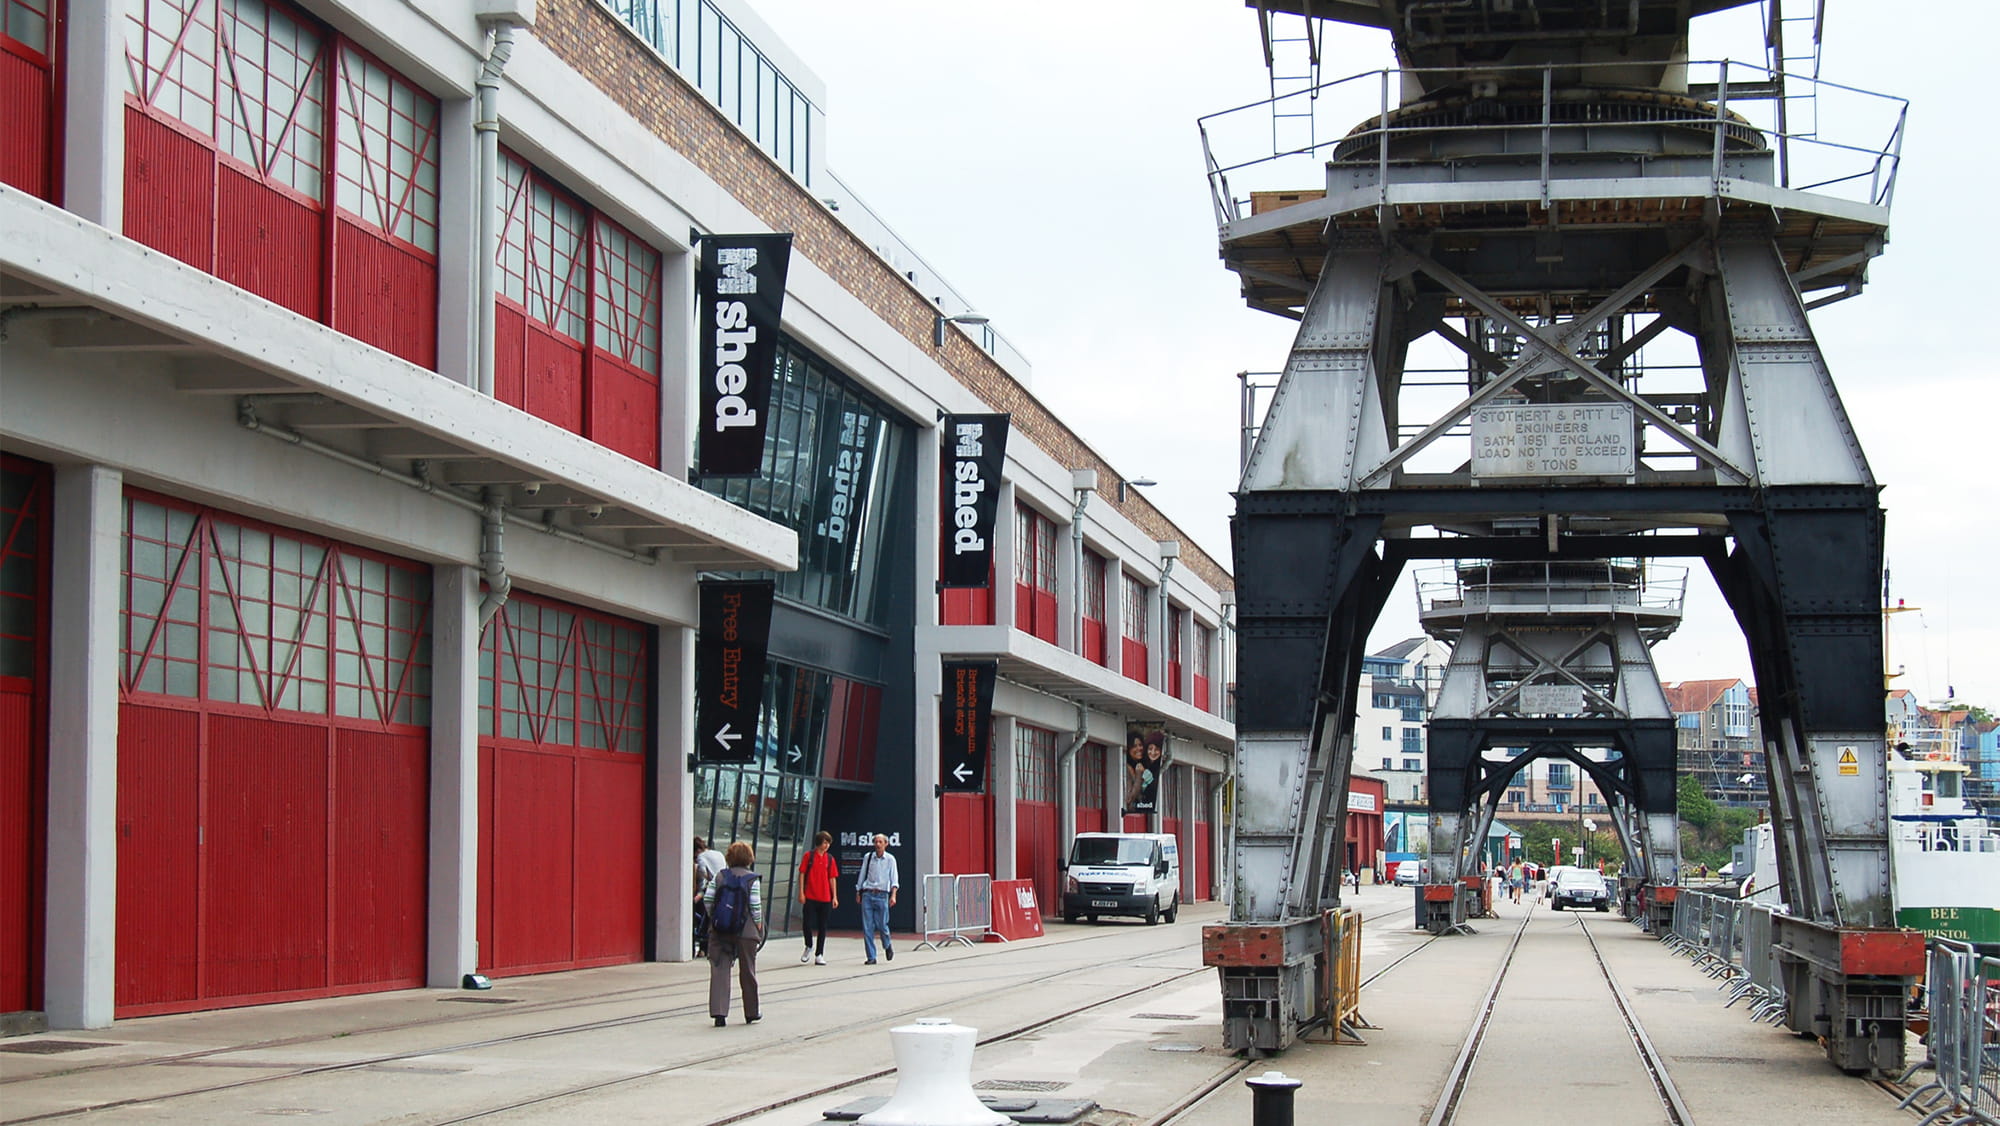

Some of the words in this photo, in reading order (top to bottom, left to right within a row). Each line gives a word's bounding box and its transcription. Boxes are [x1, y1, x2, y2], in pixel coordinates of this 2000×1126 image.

[717, 248, 757, 294] M
[716, 301, 756, 432] shed
[1480, 410, 1551, 422] STOTHERT
[1556, 411, 1566, 421] &
[1573, 409, 1604, 421] PITT
[1515, 423, 1588, 433] ENGINEERS
[956, 423, 983, 457] M
[1483, 436, 1515, 446] BATH
[1559, 434, 1620, 445] ENGLAND
[1478, 448, 1510, 458] LOAD
[1518, 447, 1541, 457] NOT
[1553, 447, 1567, 457] TO
[1575, 446, 1627, 456] EXCEED
[1541, 459, 1578, 470] TONS
[955, 461, 985, 555] shed
[724, 593, 741, 641] Free
[720, 648, 741, 709] Entry
[841, 832, 857, 846] M
[858, 832, 901, 846] shd
[1930, 908, 1959, 919] BEE
